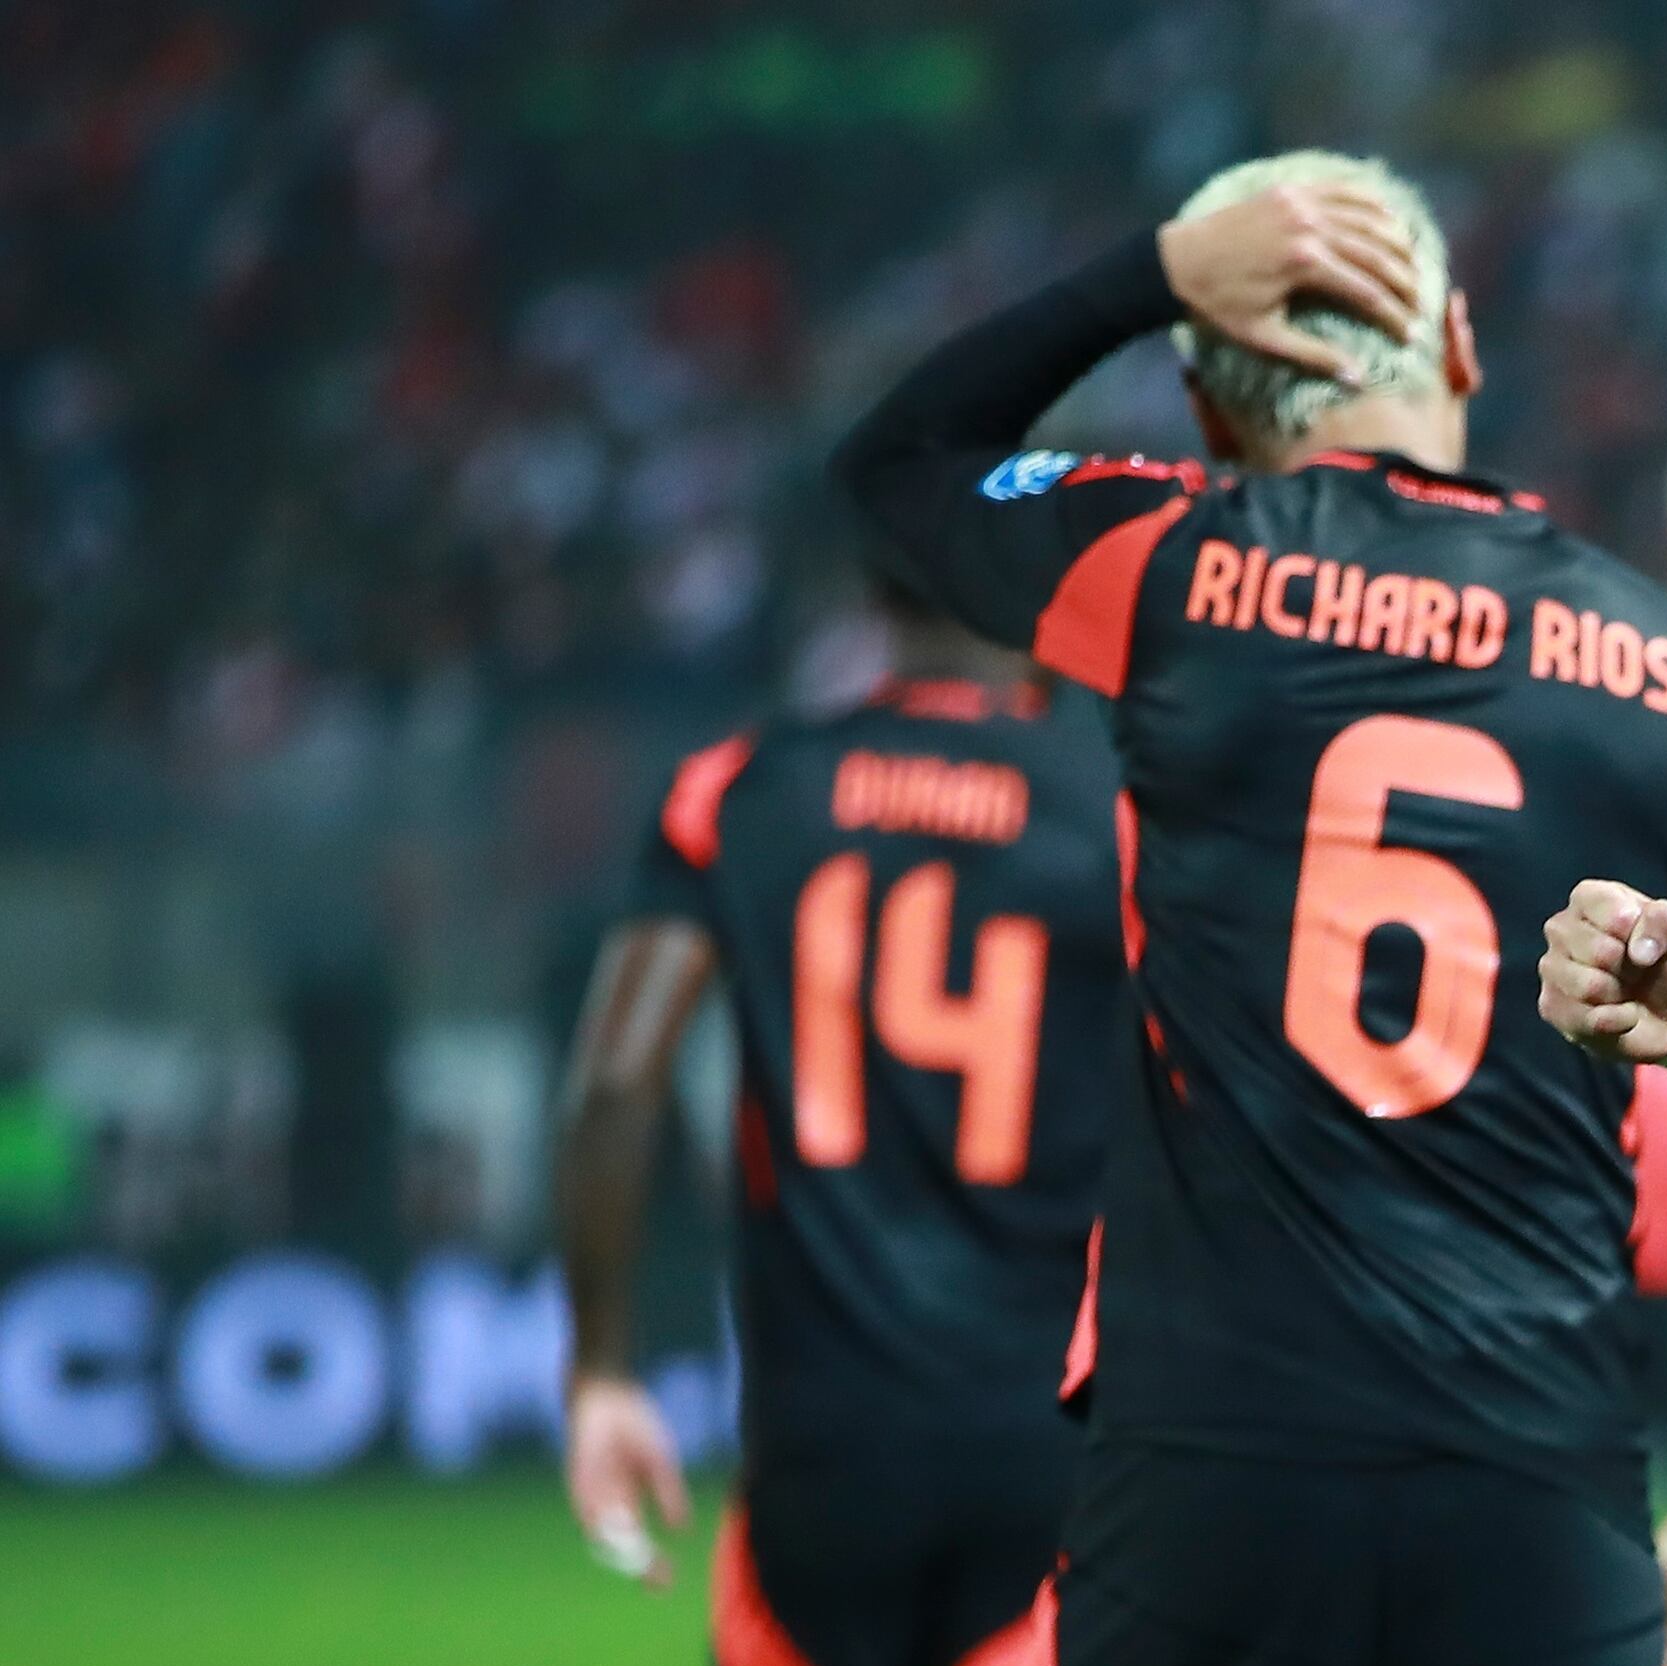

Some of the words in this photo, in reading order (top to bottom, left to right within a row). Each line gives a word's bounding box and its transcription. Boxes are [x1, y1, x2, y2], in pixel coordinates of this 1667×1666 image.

[1186, 538, 1507, 670] RICHARD
[792, 850, 1049, 1187] 14
[1283, 713, 1525, 1119] 6
